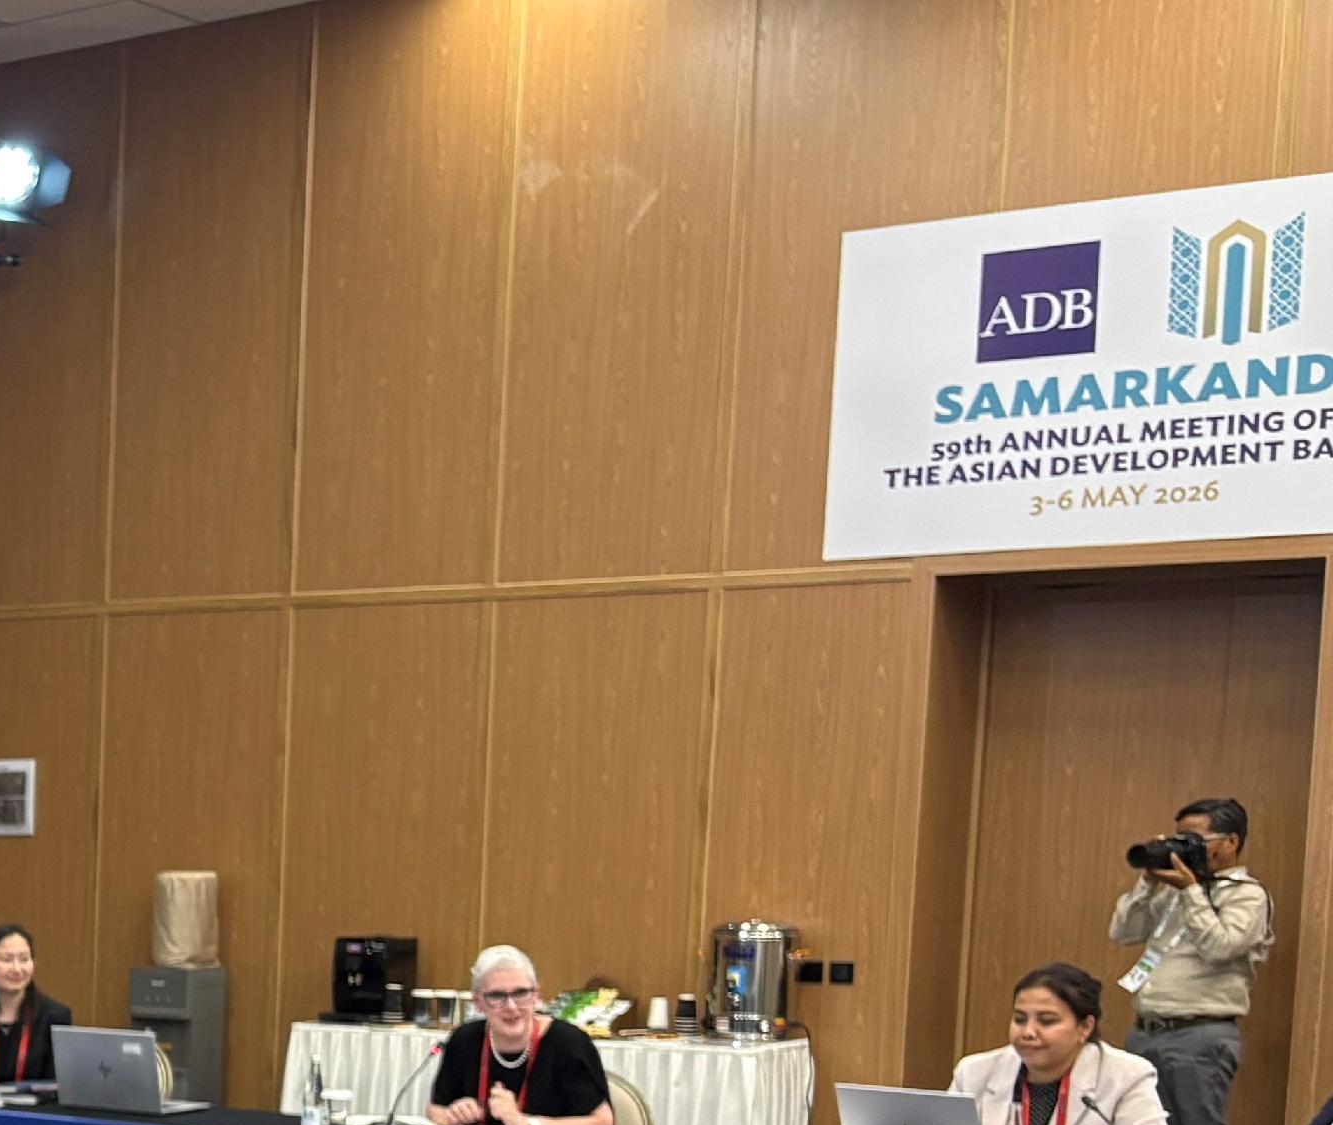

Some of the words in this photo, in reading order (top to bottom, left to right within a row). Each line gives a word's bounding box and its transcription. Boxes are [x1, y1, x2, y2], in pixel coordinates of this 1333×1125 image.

[978, 288, 1094, 338] ADB
[933, 353, 1333, 425] SAMARKAND
[931, 434, 991, 462] 59th
[999, 422, 1131, 453] ANNUAL
[1140, 411, 1284, 443] MEETING
[1293, 407, 1333, 431] OF
[884, 464, 941, 489] THE
[946, 457, 1041, 485] ASIAN
[1050, 440, 1284, 477] DEVELOPMENT
[1293, 437, 1333, 460] BA
[1029, 493, 1073, 517] 3-6
[1081, 483, 1149, 509] MAY
[1155, 480, 1220, 505] 2026
